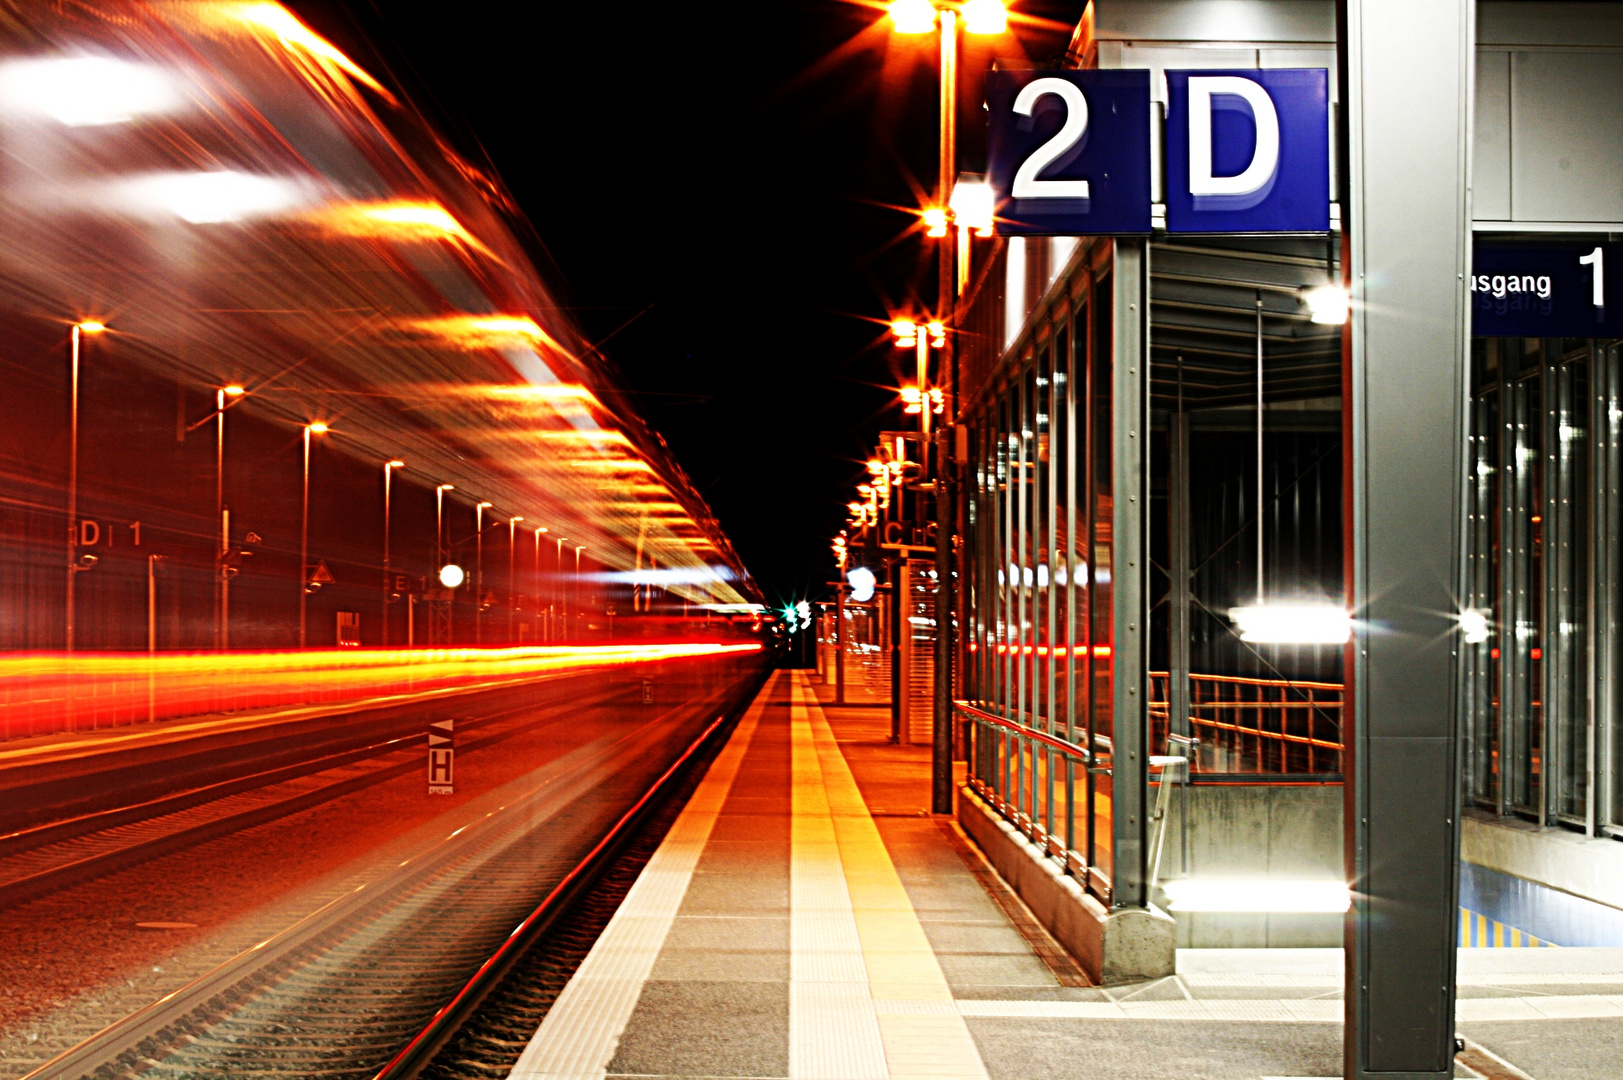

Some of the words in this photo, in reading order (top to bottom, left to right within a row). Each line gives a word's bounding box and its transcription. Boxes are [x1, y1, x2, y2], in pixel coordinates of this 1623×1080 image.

[1012, 77, 1089, 198] 2
[1188, 76, 1280, 197] D
[1579, 246, 1604, 306] 1
[81, 520, 100, 546] D
[129, 521, 140, 546] 1
[884, 522, 903, 545] C
[395, 575, 406, 591] E
[431, 750, 451, 782] H
